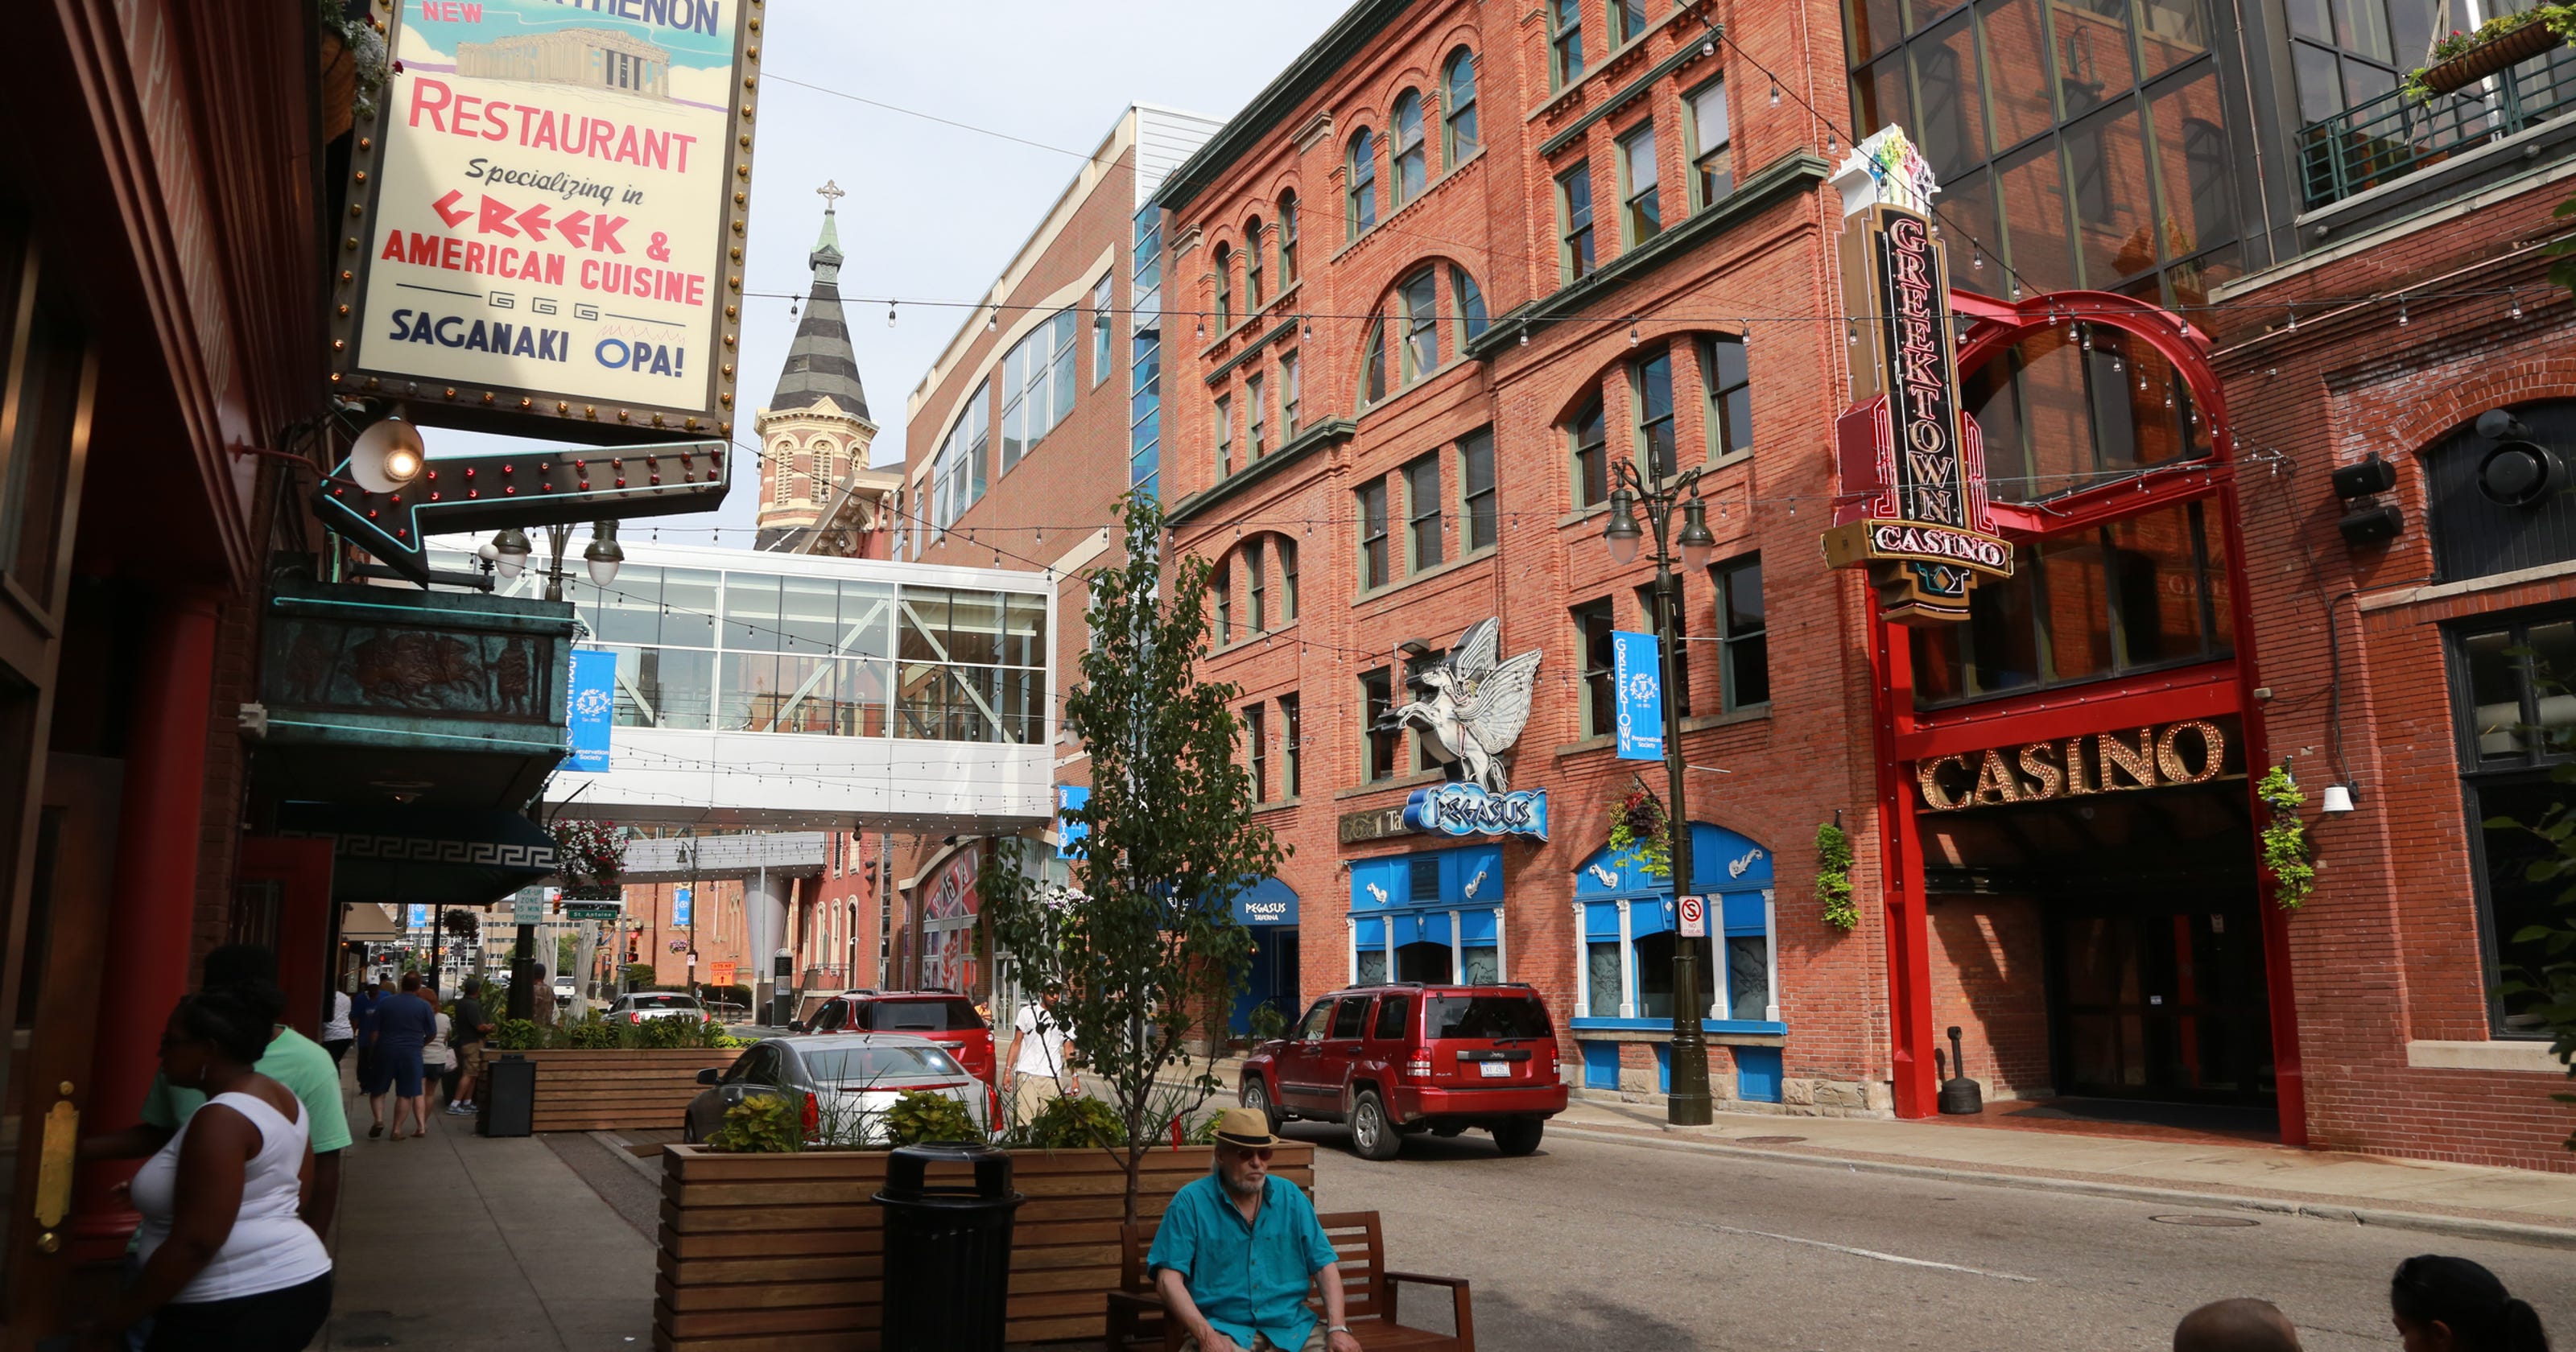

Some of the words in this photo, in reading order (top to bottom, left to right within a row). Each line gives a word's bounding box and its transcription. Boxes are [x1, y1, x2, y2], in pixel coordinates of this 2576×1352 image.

[422, 0, 482, 23] NEW
[408, 76, 697, 174] RESTAURANT
[464, 158, 614, 207] Specializing
[621, 188, 643, 205] in
[431, 188, 630, 255] GREEK
[646, 231, 671, 263] &
[381, 229, 566, 286] AMERICAN
[580, 258, 705, 307] CUISINE
[389, 308, 568, 362] SAGANAKI
[595, 338, 684, 377] OPA!
[1890, 218, 1955, 525] GREEKTOWN
[1875, 524, 2007, 567] CASINO
[1615, 638, 1632, 752] GREEKTOWN
[1631, 735, 1662, 743] Preservation
[1637, 741, 1656, 749] Society
[1922, 719, 2225, 810] CASINO
[1434, 795, 1531, 827] PEGASUS
[520, 897, 539, 905] ZONE
[1245, 902, 1286, 913] PEGASUS
[1489, 1050, 1505, 1058] Jeep
